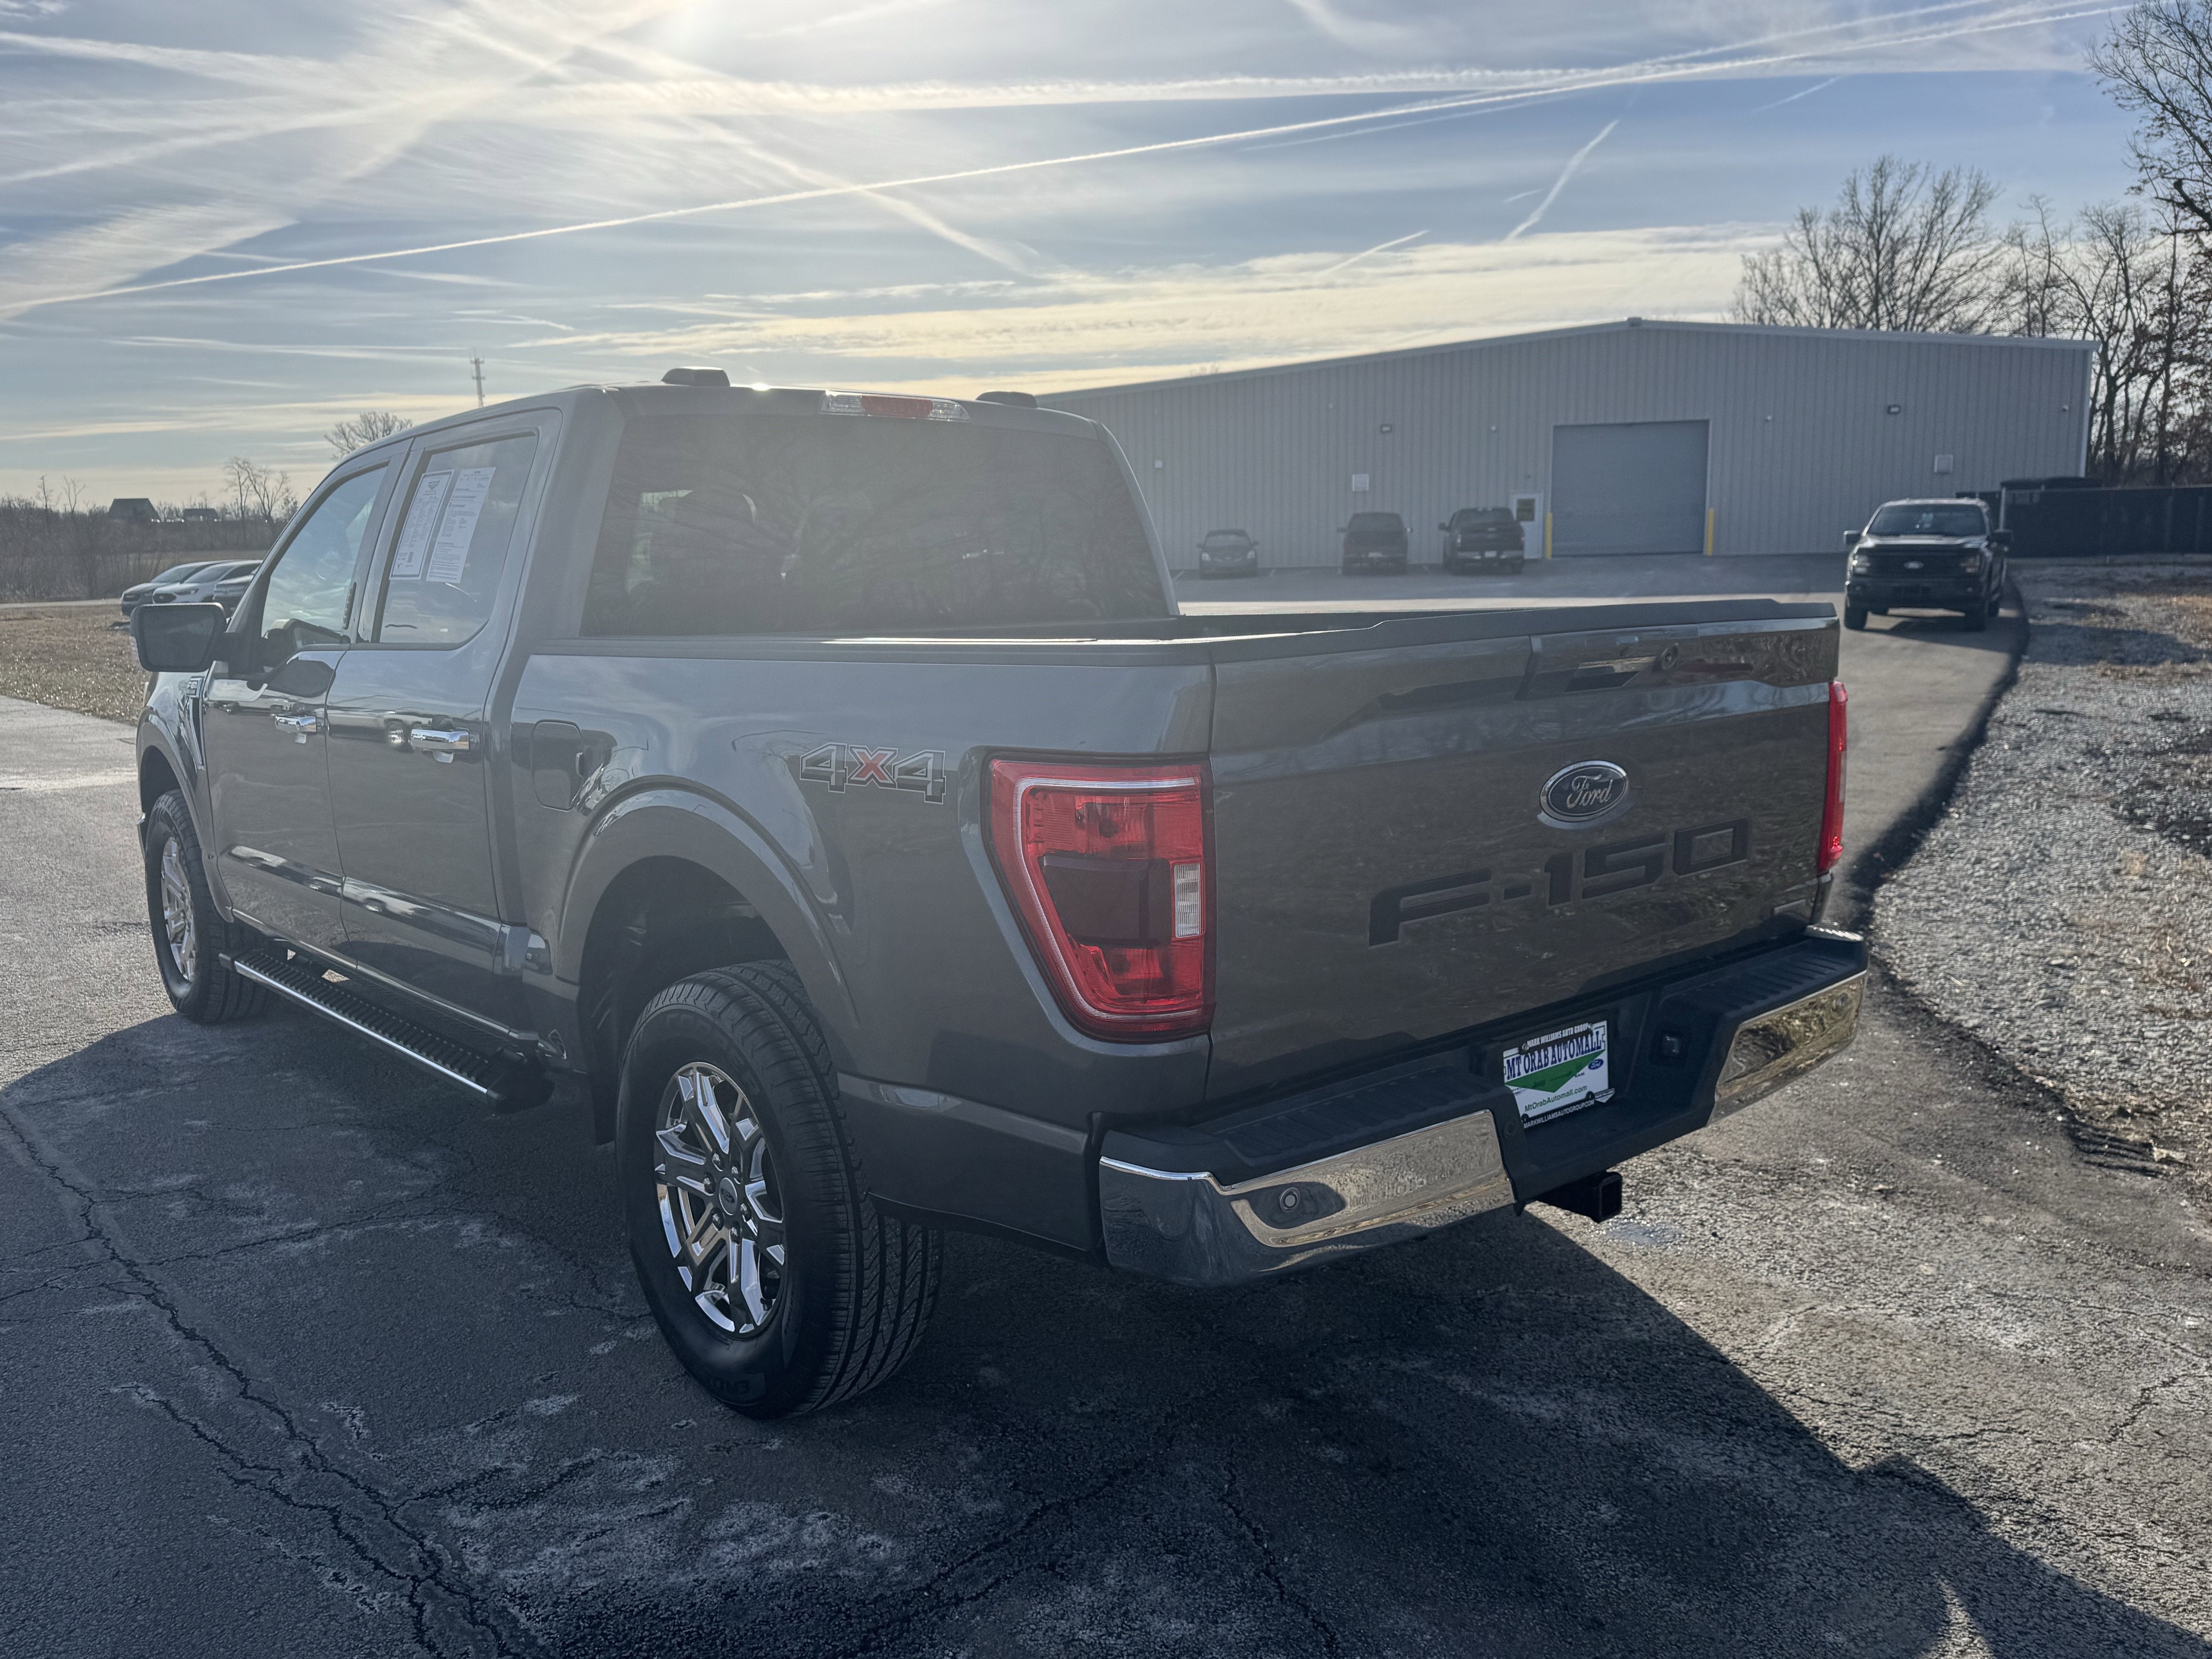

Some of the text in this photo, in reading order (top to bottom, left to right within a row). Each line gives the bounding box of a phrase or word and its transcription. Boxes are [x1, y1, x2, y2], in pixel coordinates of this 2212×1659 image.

[1566, 774, 1613, 809] Ford
[1368, 818, 1750, 947] F-150
[1540, 1030, 1562, 1044] WILLIAMS
[1562, 1027, 1573, 1037] AUTO
[1506, 1030, 1602, 1080] MT ORAB AUTOMALL
[1525, 1085, 1587, 1112] MtOrabAutomall.com
